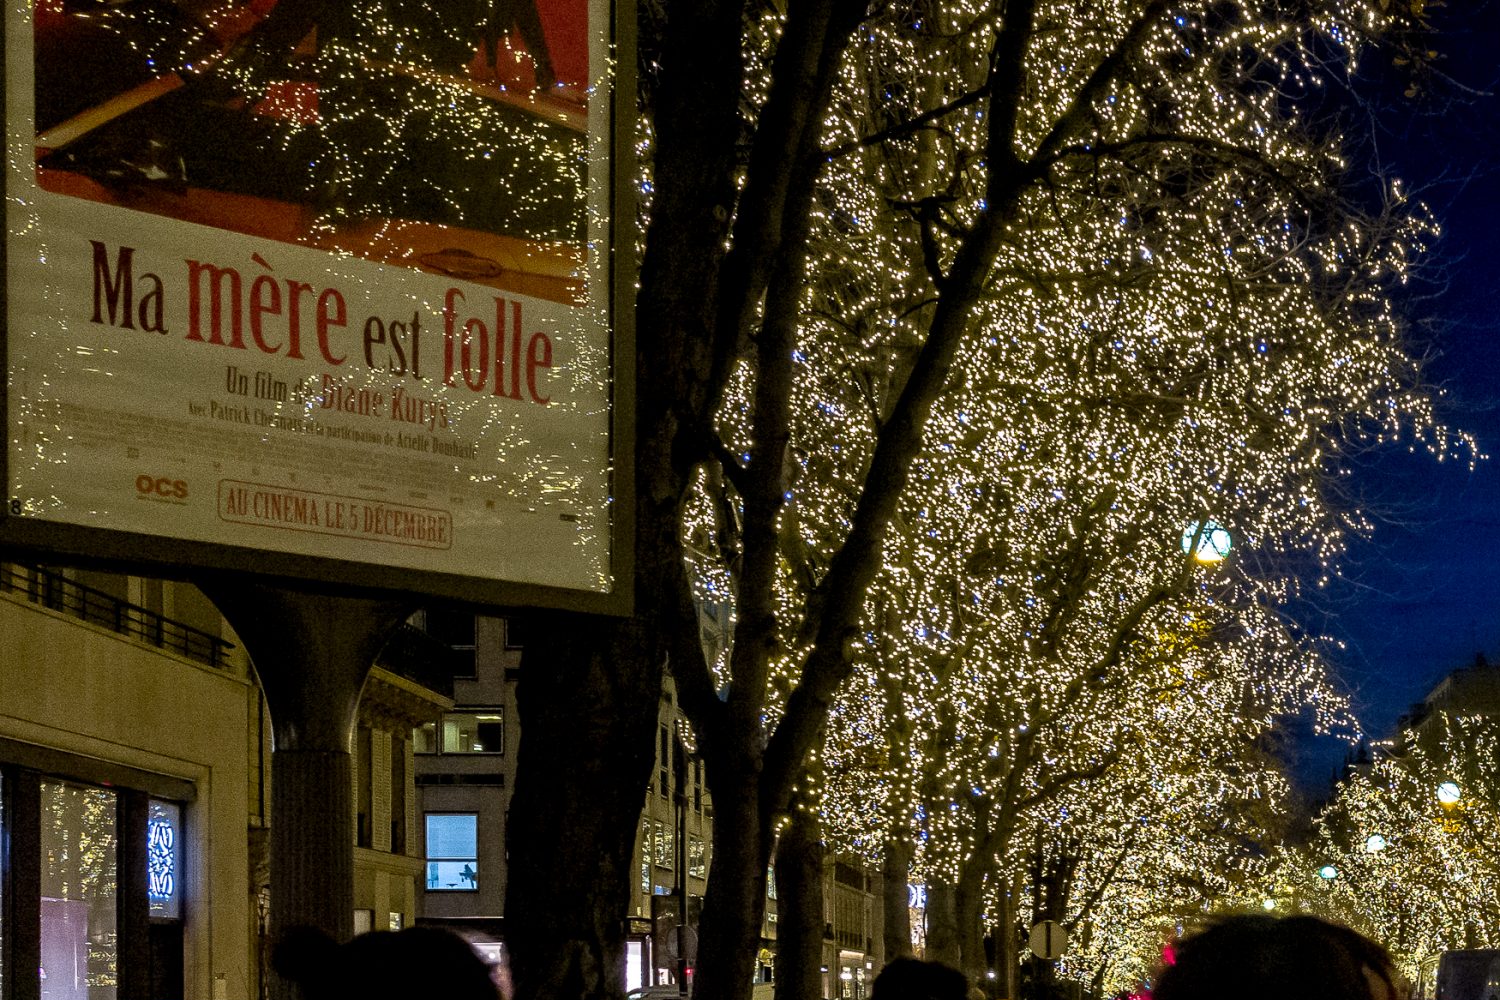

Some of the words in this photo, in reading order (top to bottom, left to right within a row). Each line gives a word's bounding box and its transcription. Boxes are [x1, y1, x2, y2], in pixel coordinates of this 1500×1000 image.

[89, 240, 169, 335] Ma
[184, 252, 347, 365] mère
[363, 311, 424, 380] est
[442, 287, 553, 405] folle
[211, 401, 250, 424] Patrick
[226, 366, 248, 396] Un
[255, 371, 288, 402] film
[293, 378, 314, 405] de
[320, 373, 383, 418] Diane
[391, 386, 449, 432] Kurys
[135, 474, 188, 498] OCS
[11, 499, 22, 515] 8
[227, 488, 248, 515] AU
[325, 501, 345, 529] LE
[350, 504, 359, 531] 5
